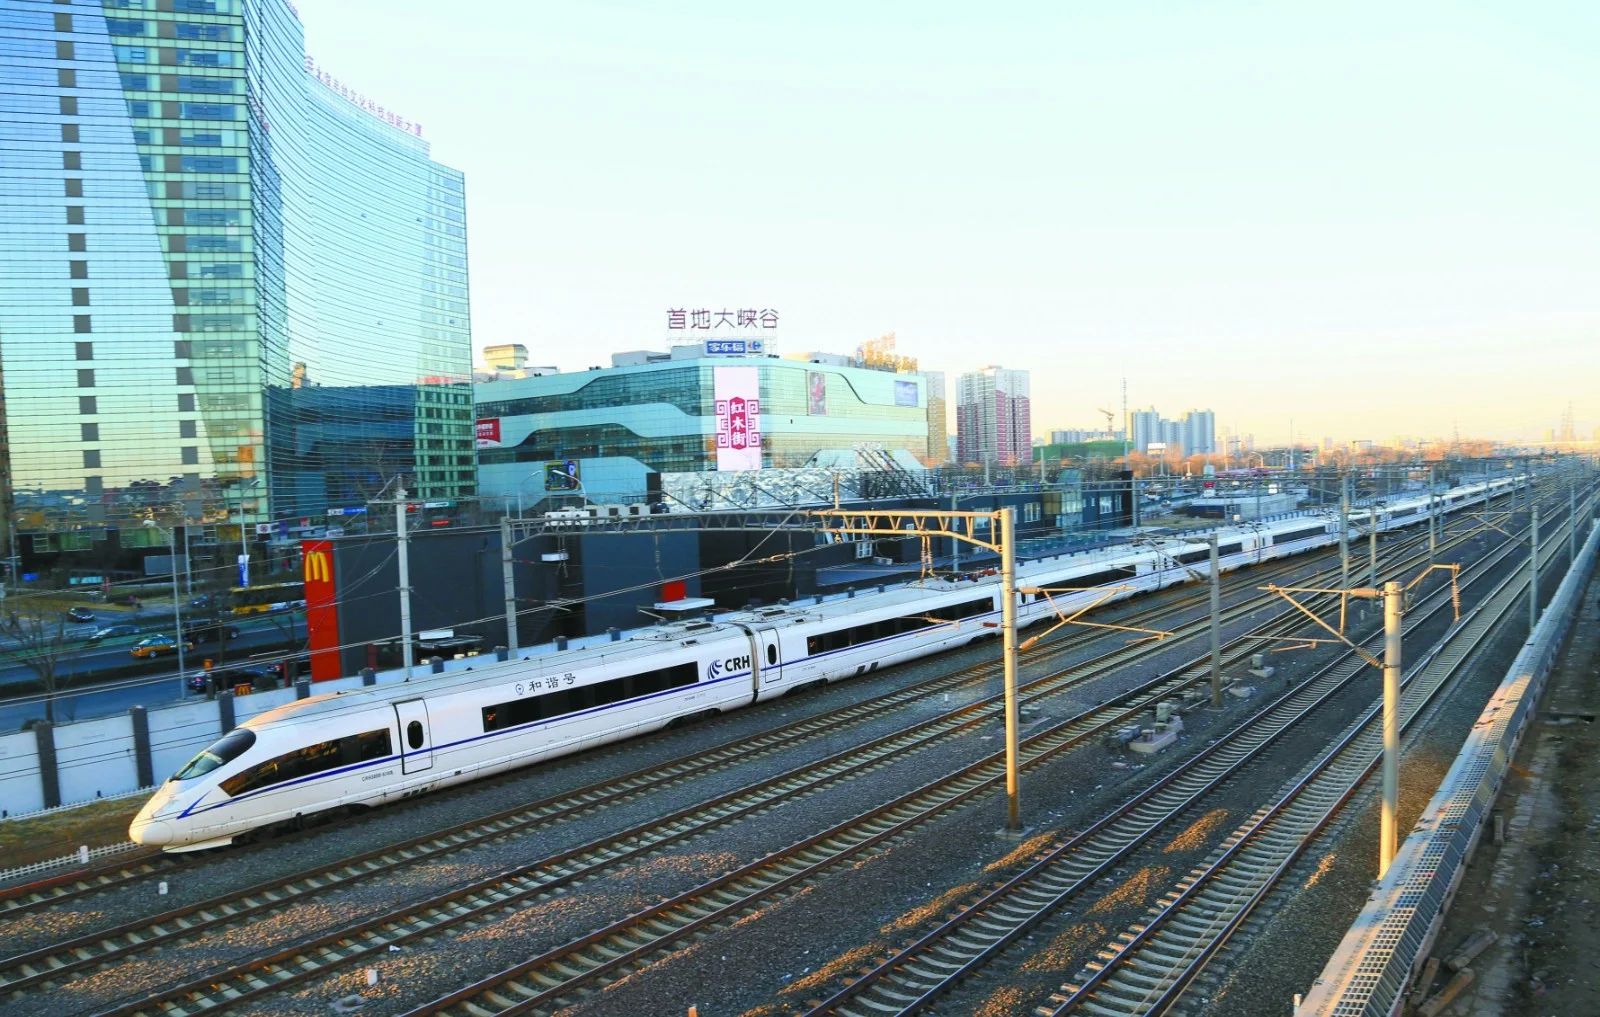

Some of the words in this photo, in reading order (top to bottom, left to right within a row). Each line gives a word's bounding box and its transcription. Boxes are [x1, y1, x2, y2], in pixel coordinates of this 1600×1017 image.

[666, 307, 779, 329] 首地大峡谷
[730, 401, 746, 446] 红木街
[724, 655, 751, 672] CRH
[528, 672, 576, 692] 和谐号
